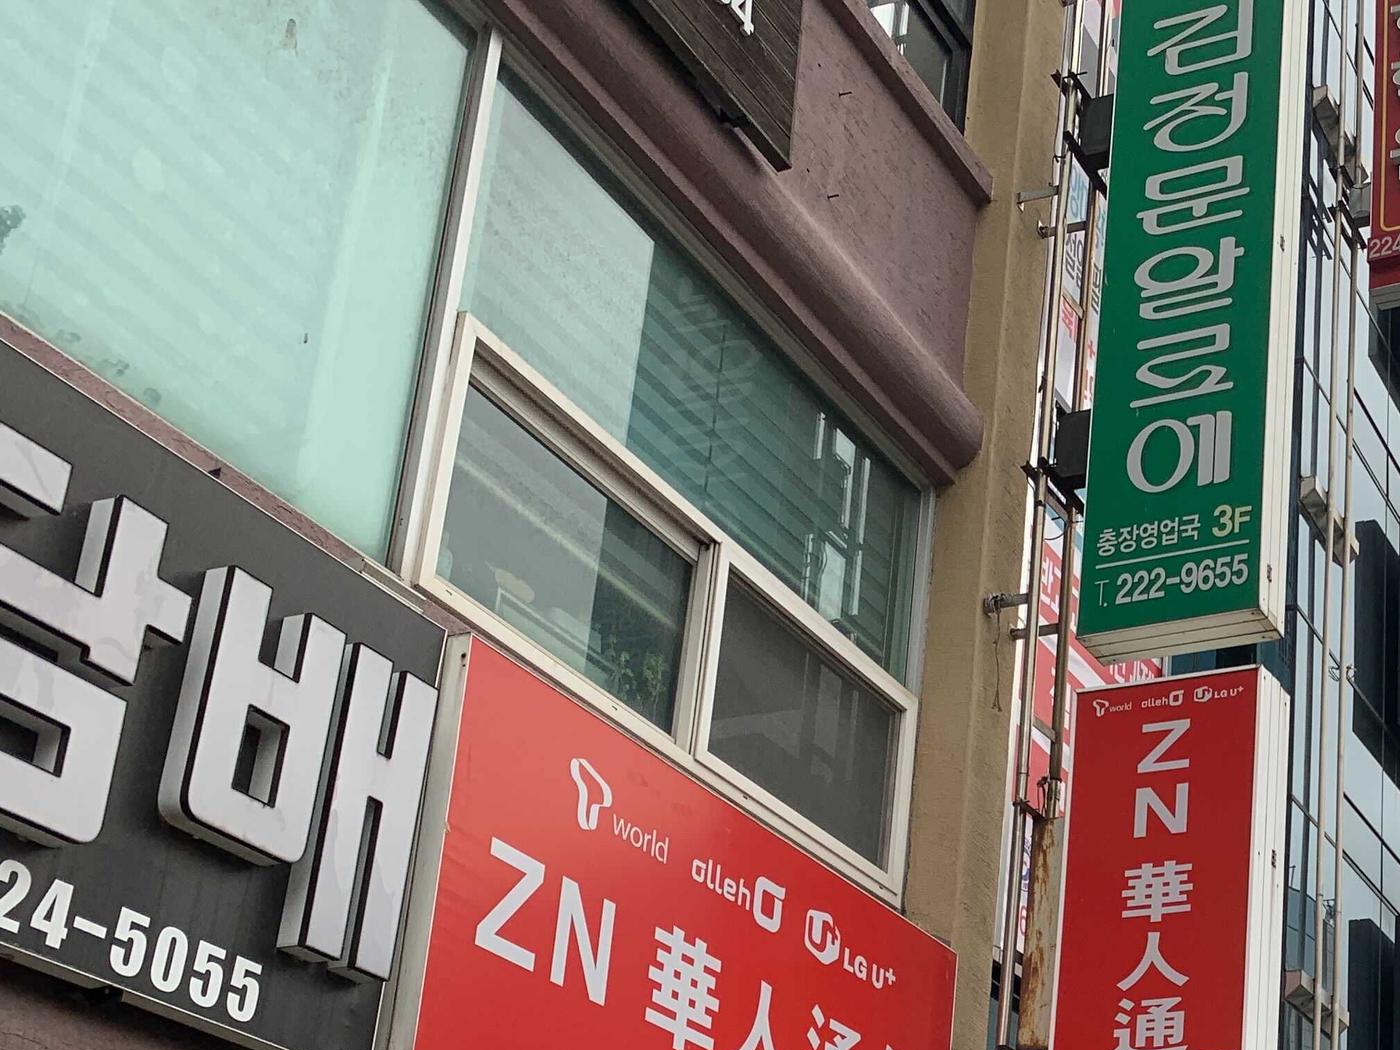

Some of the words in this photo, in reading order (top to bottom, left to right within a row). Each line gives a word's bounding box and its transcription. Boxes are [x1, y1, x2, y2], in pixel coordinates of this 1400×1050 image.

[1097, 513, 1201, 559] 충장영업국
[1211, 503, 1253, 539] 3F
[1116, 555, 1249, 605] 222-9655
[1109, 702, 1132, 713] world
[1214, 690, 1228, 698] LG
[474, 836, 617, 1008] ZN
[612, 814, 669, 864] world
[843, 947, 867, 978] LG
